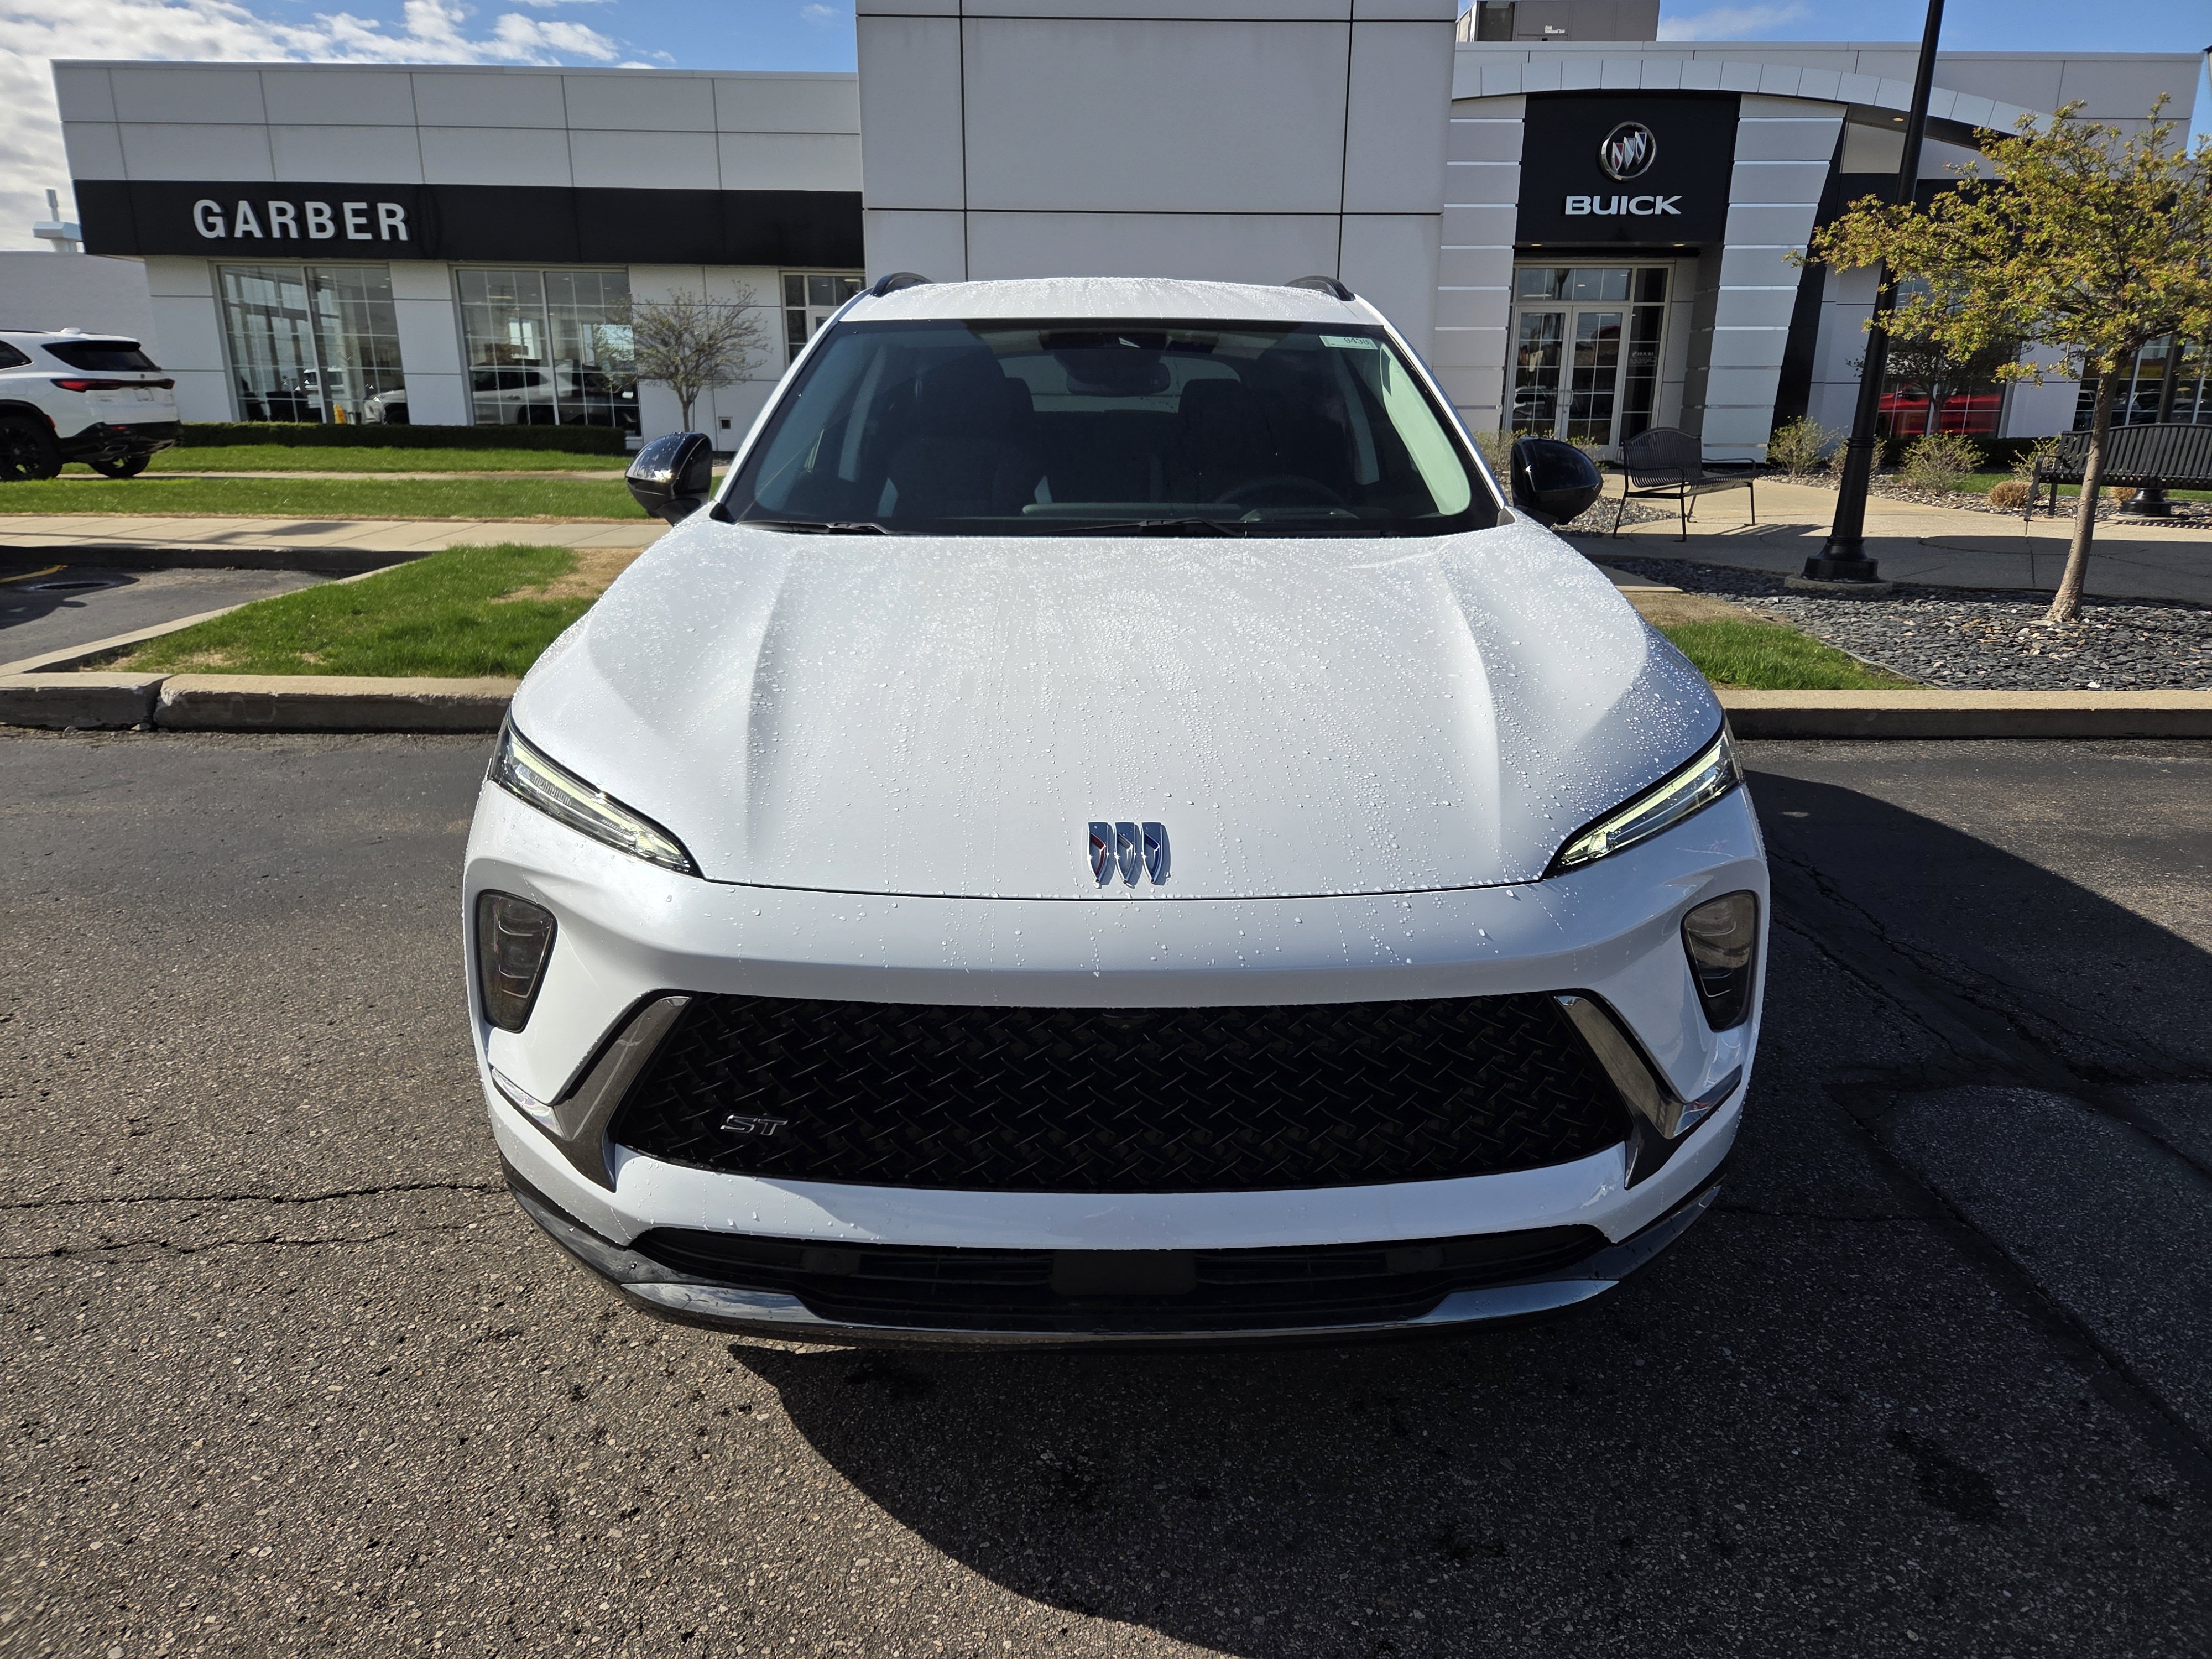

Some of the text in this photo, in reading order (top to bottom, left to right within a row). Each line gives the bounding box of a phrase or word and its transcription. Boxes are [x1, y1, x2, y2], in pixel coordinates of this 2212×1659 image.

[1565, 195, 1682, 215] BUICK
[194, 199, 409, 241] GARBER
[720, 1114, 789, 1136] ST
